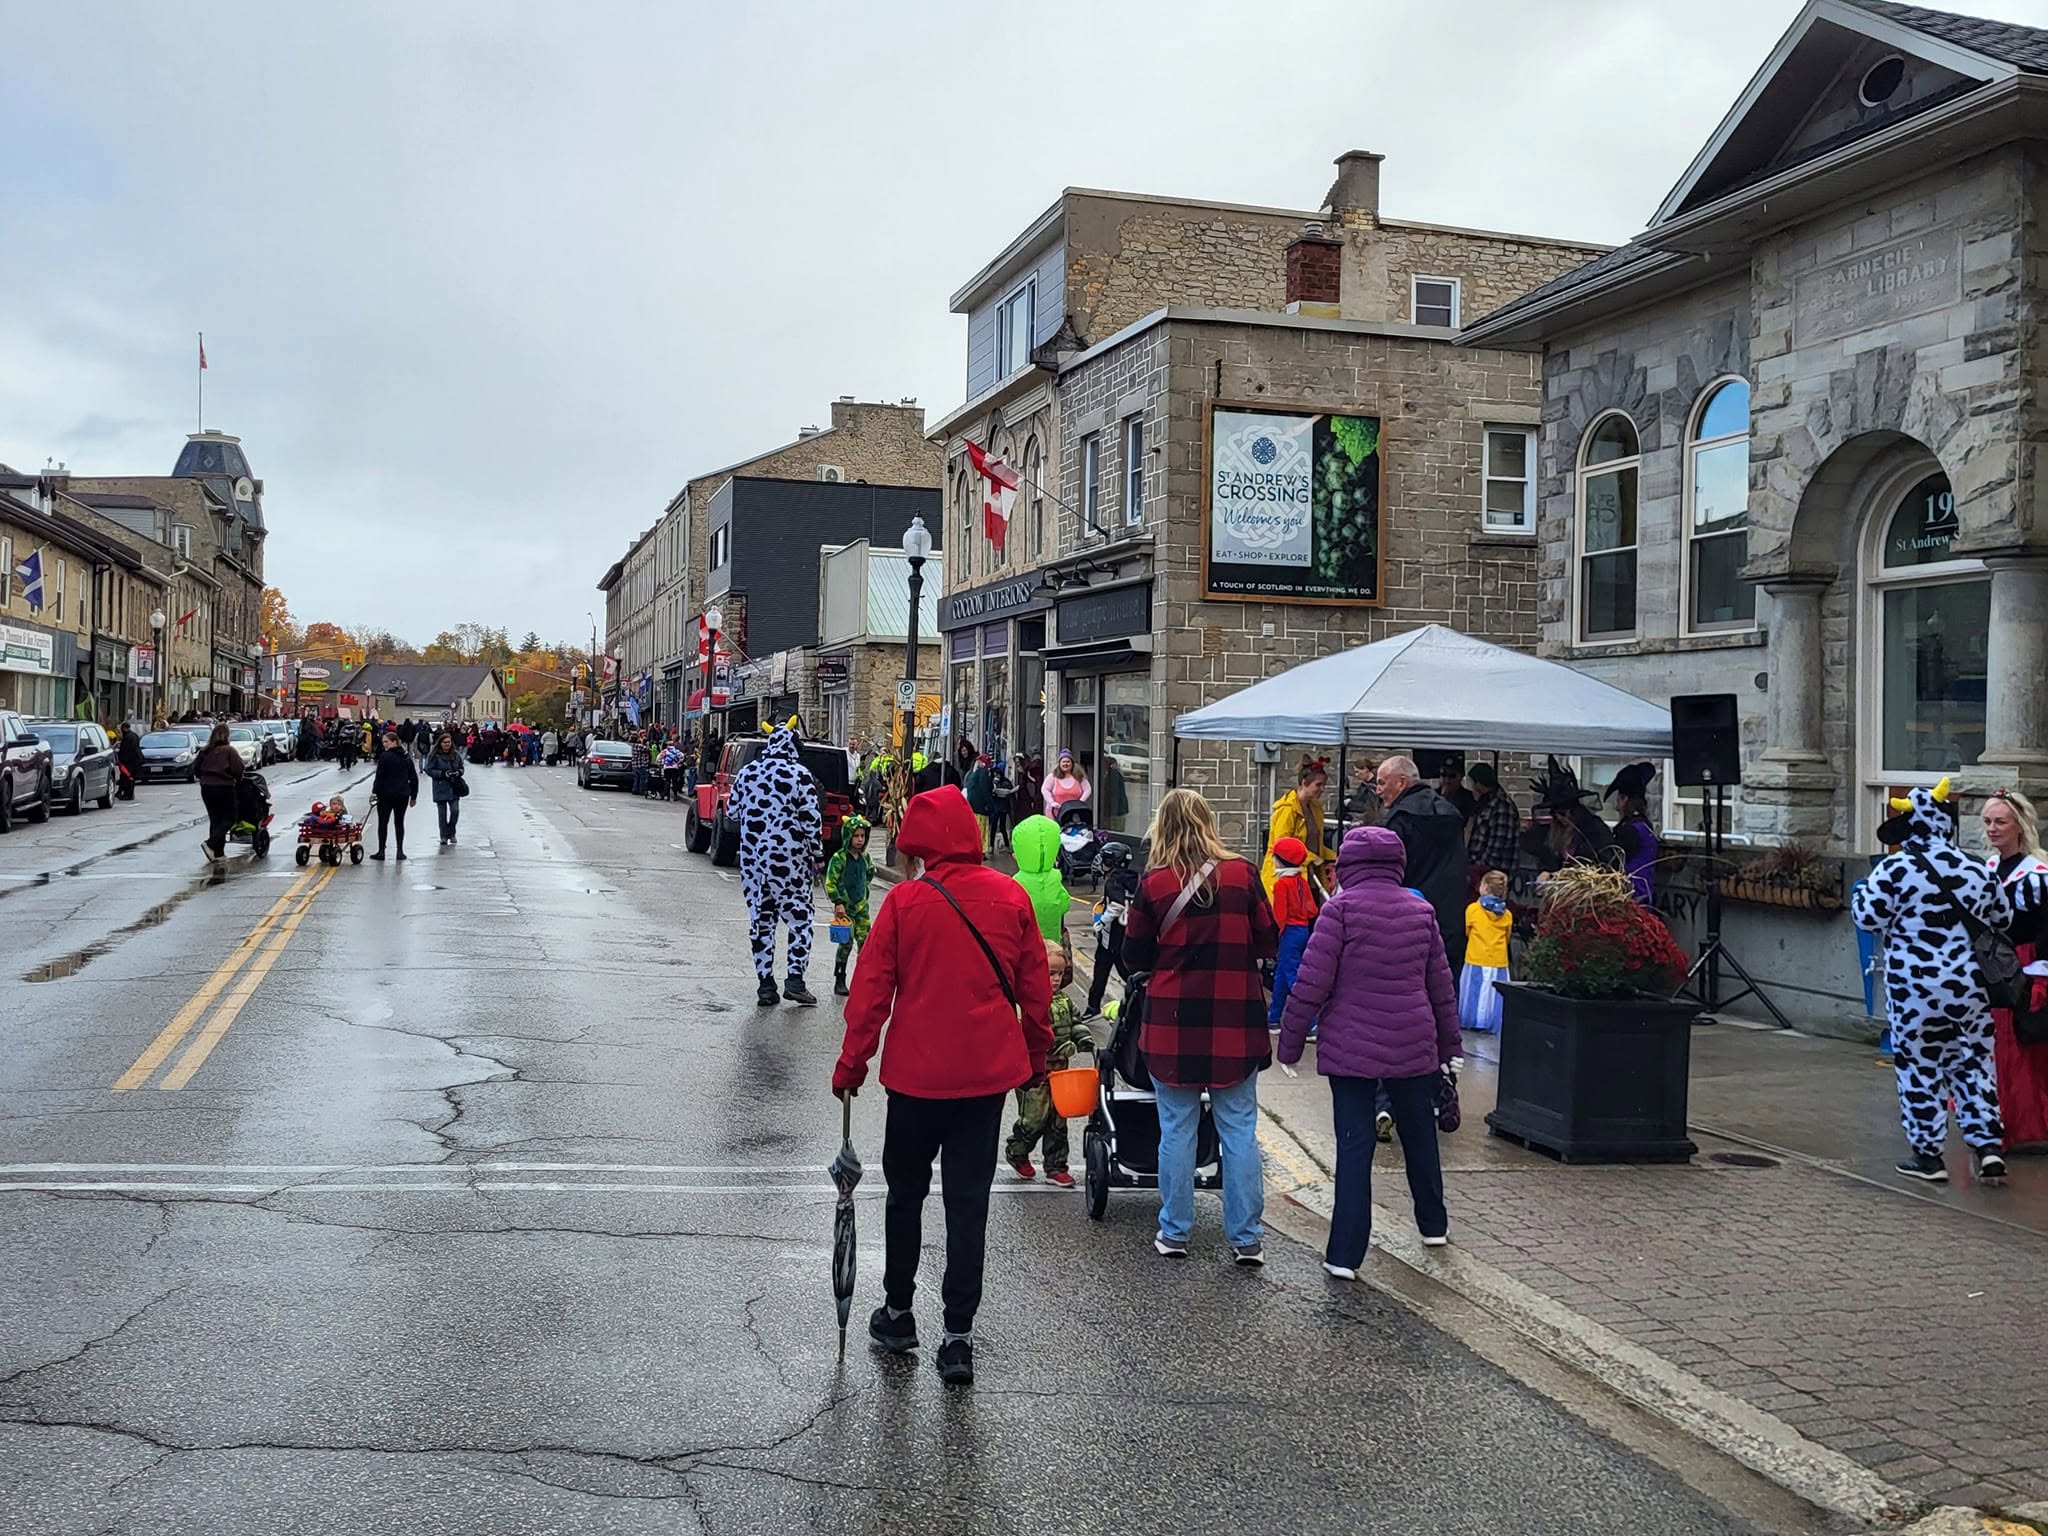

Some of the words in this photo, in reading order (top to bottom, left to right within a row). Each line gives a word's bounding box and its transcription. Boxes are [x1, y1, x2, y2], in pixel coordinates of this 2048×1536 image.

[1867, 255, 1949, 297] LIBRARY
[1232, 472, 1309, 488] ANDREW'S
[1217, 483, 1309, 503] CROSSING
[1223, 506, 1281, 526] Welcomes
[1281, 516, 1302, 534] you
[1896, 538, 1907, 551] St
[1909, 534, 1950, 550] Andrew
[1216, 550, 1232, 558] EAT
[1238, 551, 1263, 559] SHOP
[1269, 552, 1309, 562] EXPLORE
[986, 581, 1031, 611] INTERIORS
[1246, 582, 1256, 590] OF
[1257, 583, 1293, 591] SCOTLAND
[1305, 585, 1346, 594] EVERYTHING
